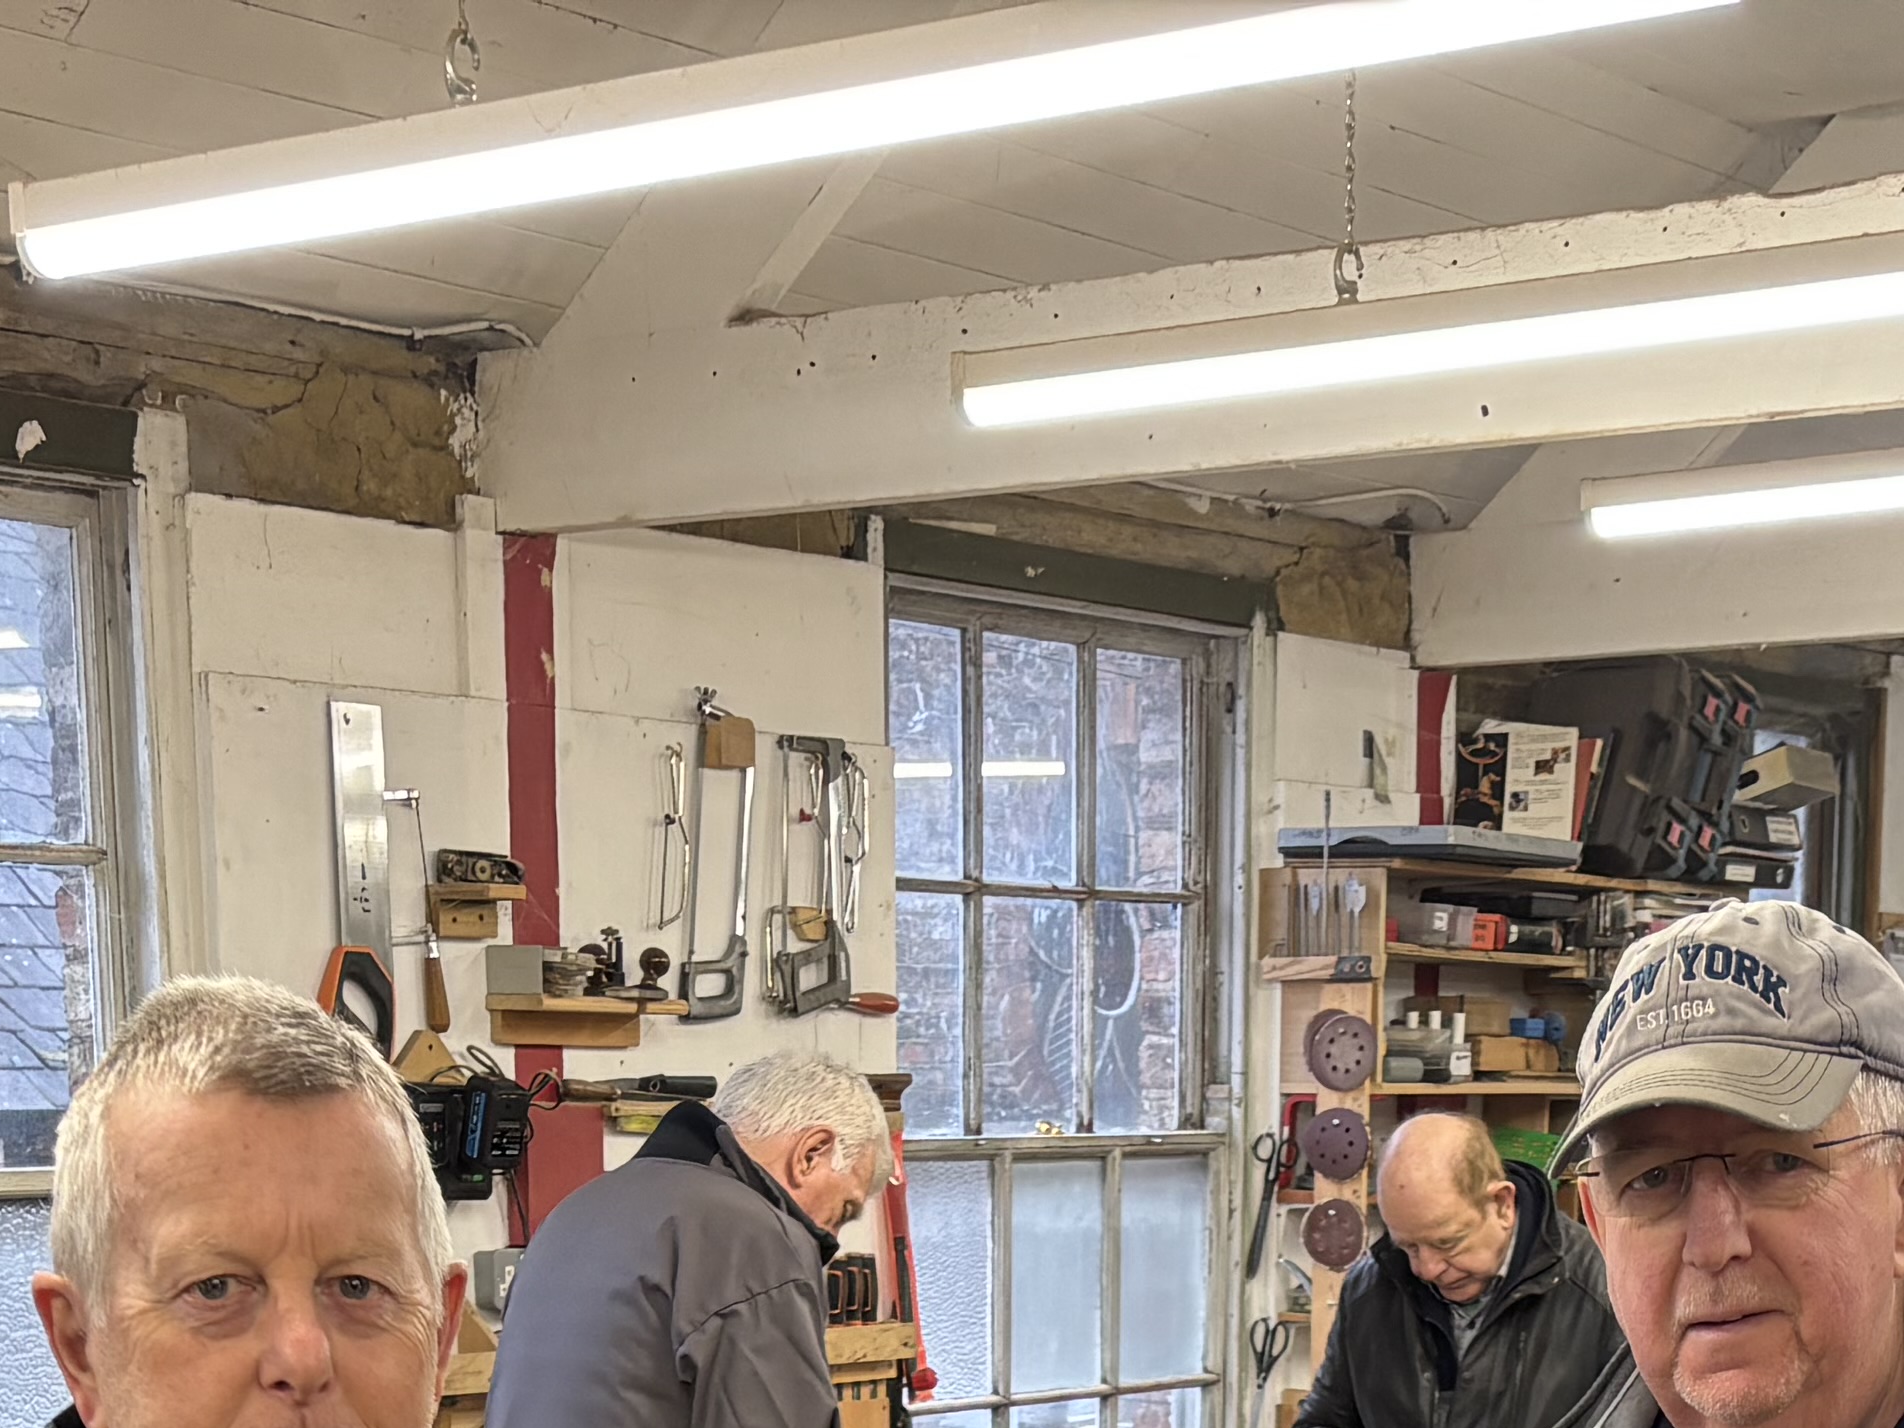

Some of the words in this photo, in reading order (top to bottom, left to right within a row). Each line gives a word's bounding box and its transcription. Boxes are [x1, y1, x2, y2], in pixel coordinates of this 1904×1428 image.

[1594, 956, 1667, 1063] NEW
[1676, 943, 1790, 1021] YORK
[1672, 999, 1716, 1022] 1664
